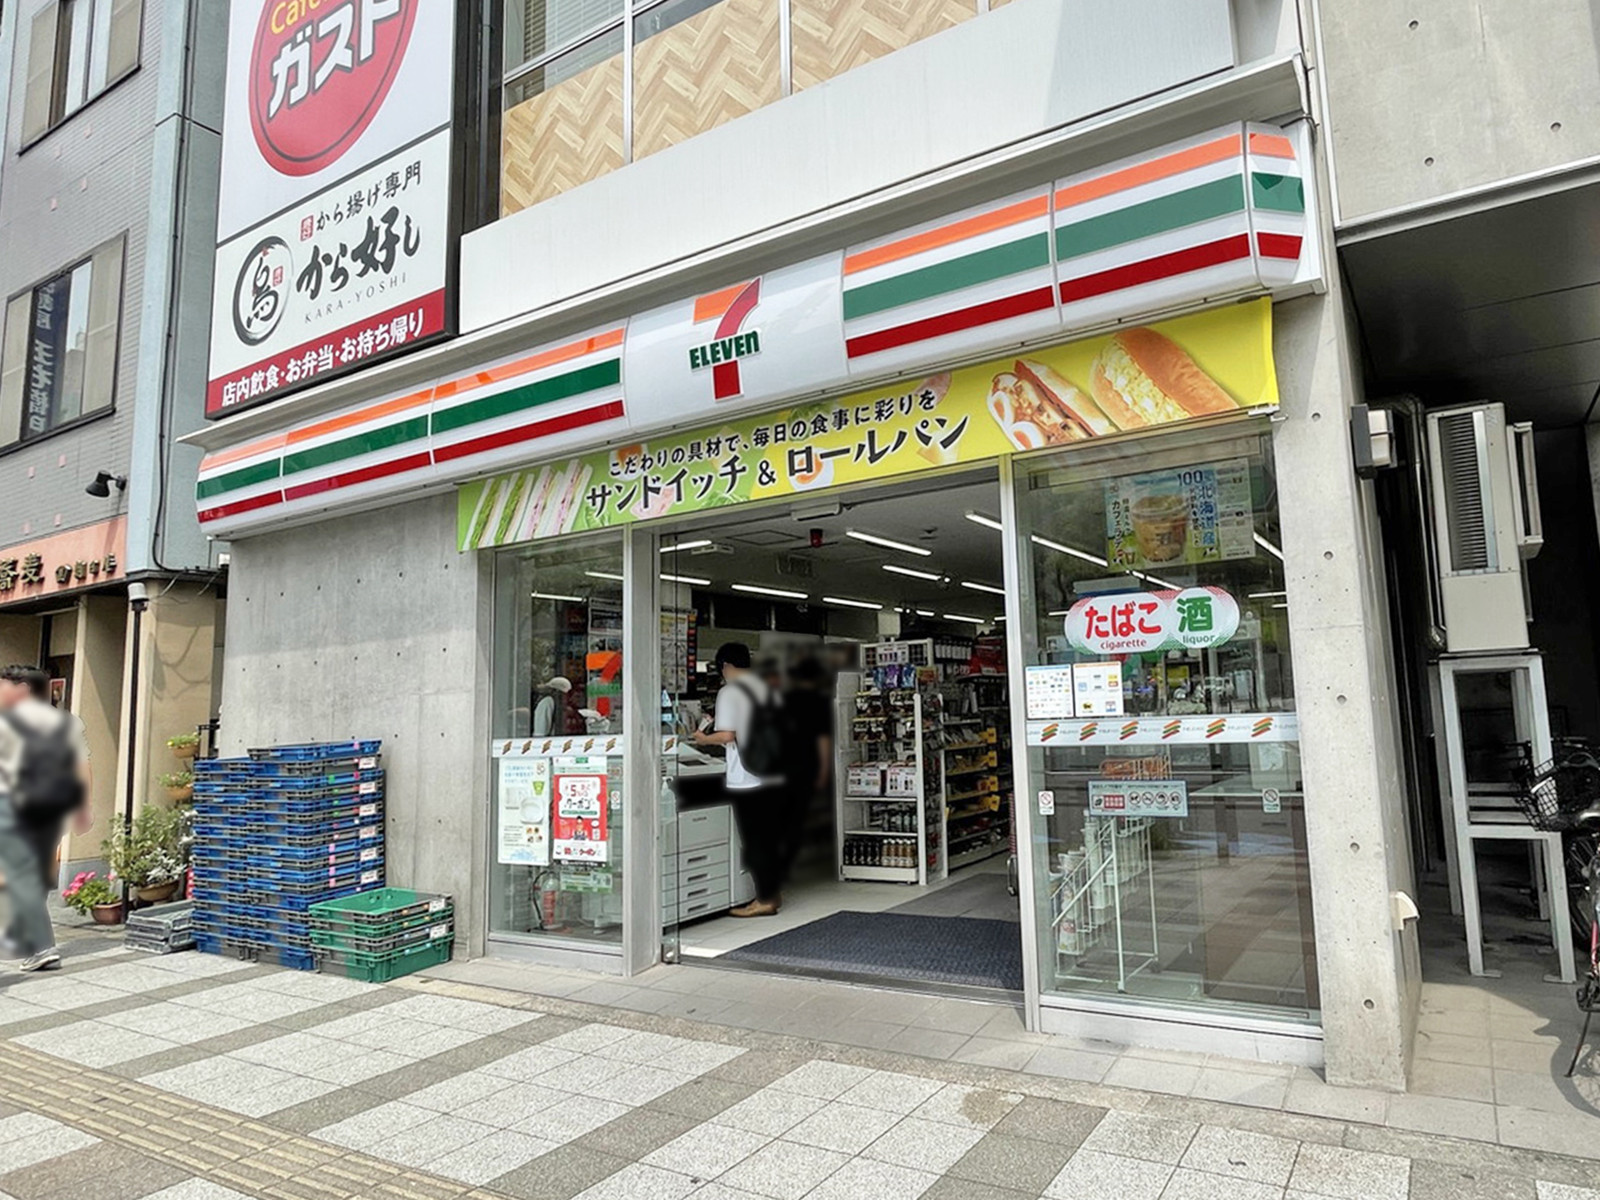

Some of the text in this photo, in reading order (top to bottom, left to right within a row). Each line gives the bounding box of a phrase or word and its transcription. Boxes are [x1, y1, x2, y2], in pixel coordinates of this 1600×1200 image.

[269, 0, 401, 119] ガスト
[316, 160, 421, 231] から揚げ専門
[296, 206, 421, 300] から好し
[221, 308, 424, 407] 店内飲食・お弁当・お持ち帰り
[586, 415, 969, 518] サンドイッチ & ロールパン
[610, 389, 936, 477] こだわりの具材で、毎日の食事に彩りを
[1085, 596, 1213, 640] たばこ 酒
[1100, 633, 1216, 651] cigarette liquor
